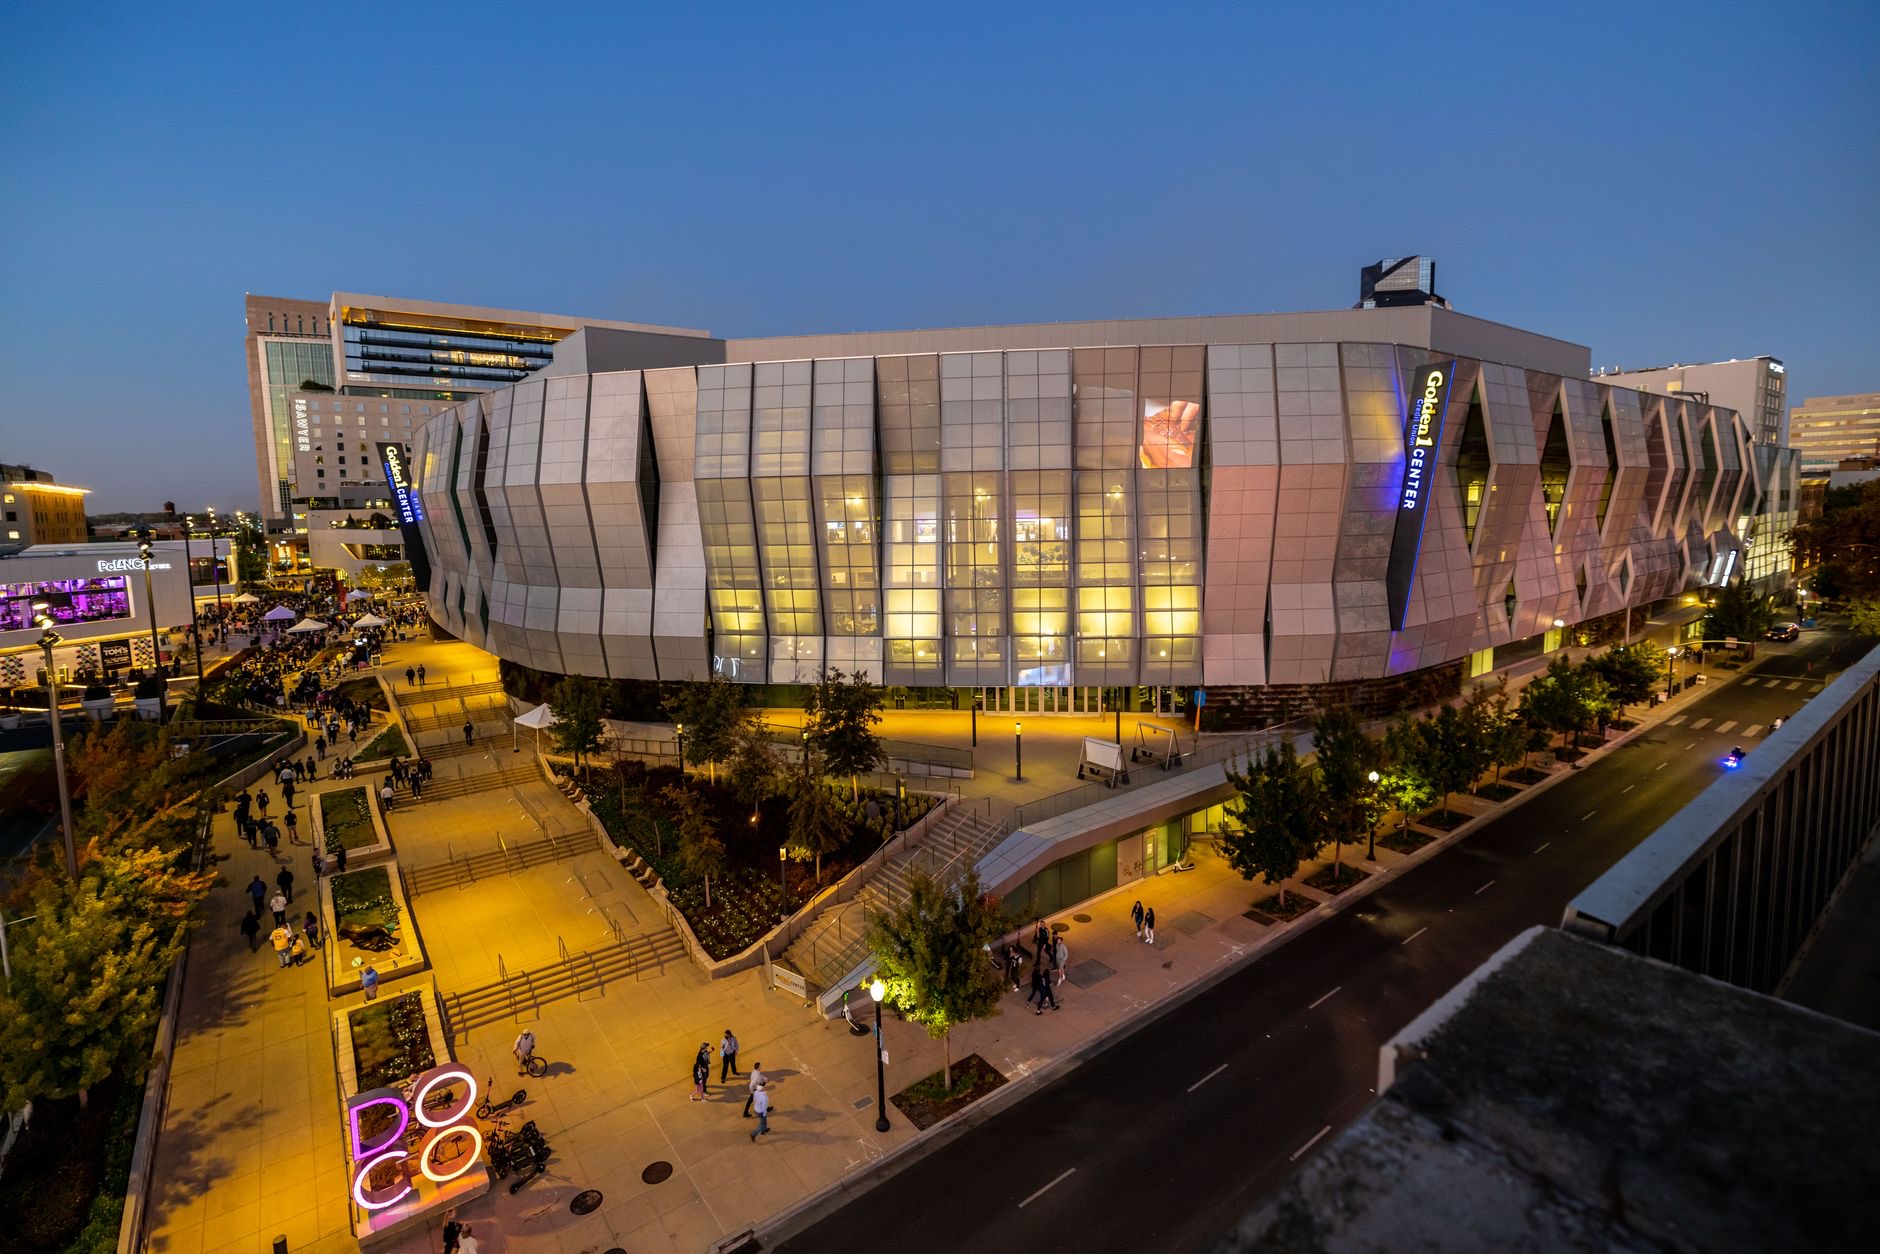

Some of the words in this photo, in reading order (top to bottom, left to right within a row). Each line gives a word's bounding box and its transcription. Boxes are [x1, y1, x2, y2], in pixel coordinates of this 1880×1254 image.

[295, 404, 310, 452] SAWYER
[1414, 399, 1424, 422] Credit
[1409, 425, 1420, 446] Union
[1403, 449, 1425, 510] CENTER
[396, 488, 414, 523] CENTER
